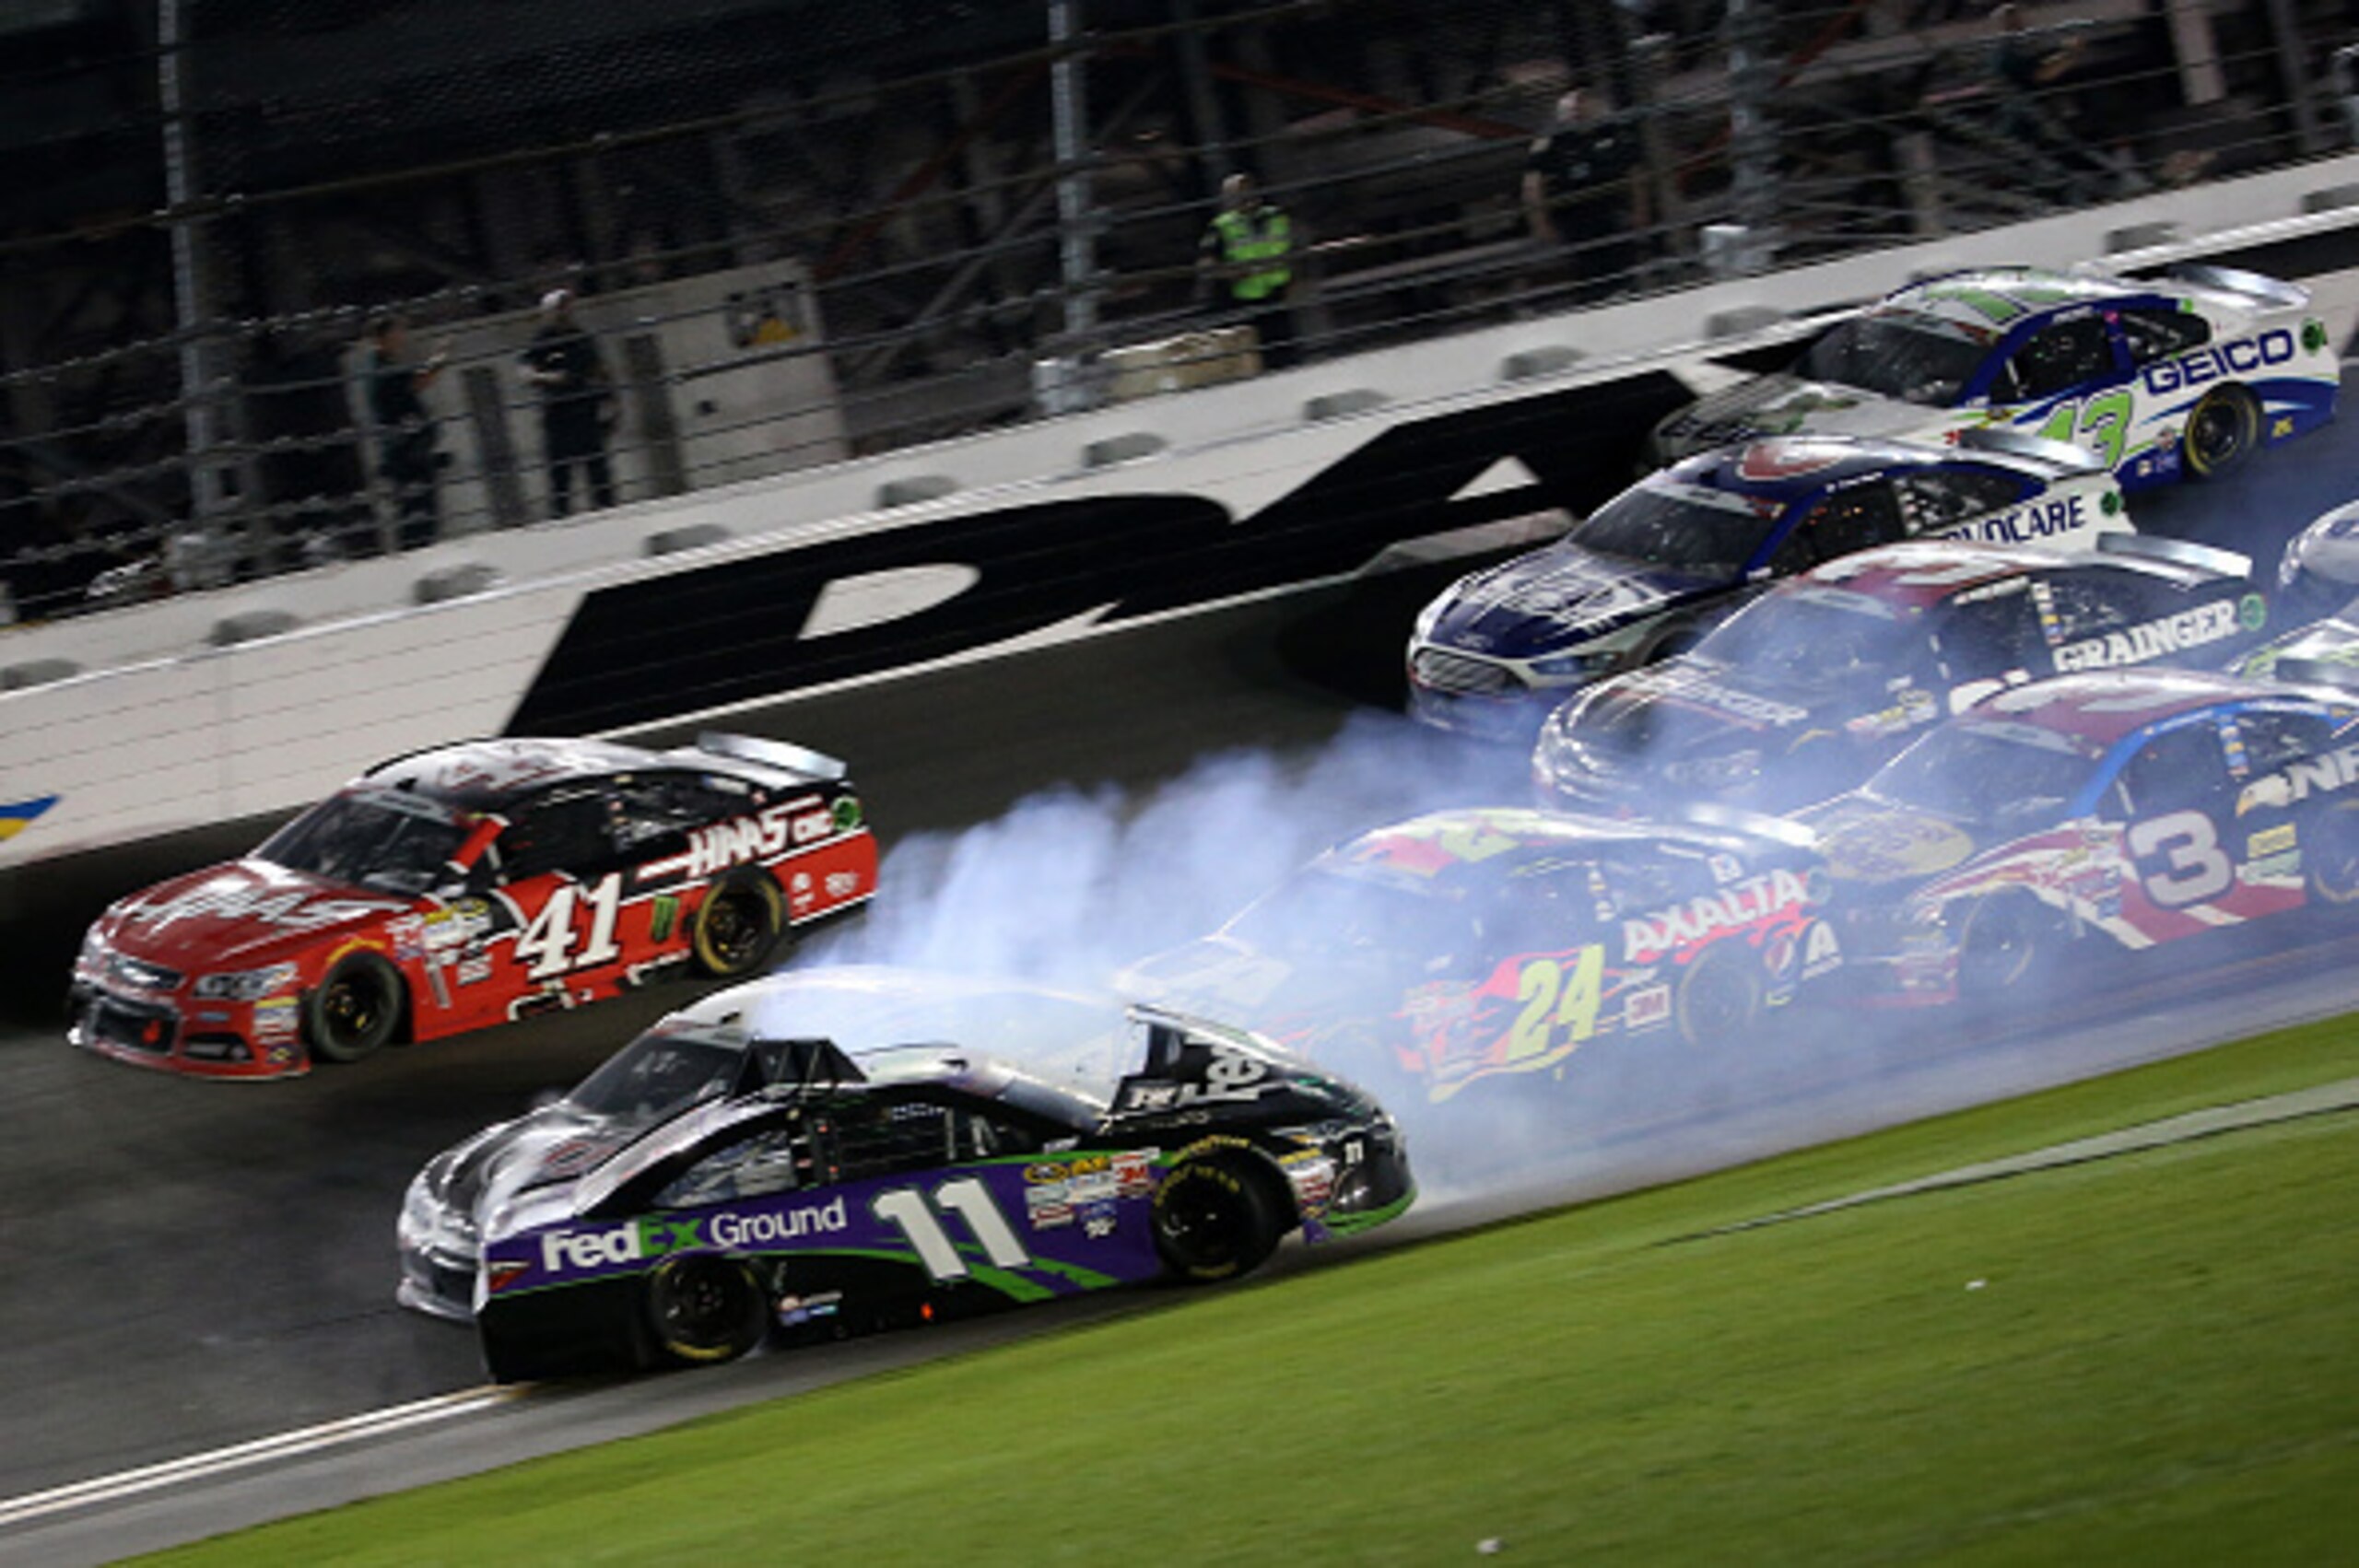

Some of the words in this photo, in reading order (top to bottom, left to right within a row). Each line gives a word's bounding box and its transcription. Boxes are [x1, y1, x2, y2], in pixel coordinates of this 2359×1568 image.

[2141, 329, 2294, 395] GEICO
[2051, 599, 2240, 673] GRAINGER
[684, 794, 823, 878] HAAS
[2129, 811, 2231, 907] 3
[515, 872, 621, 979] 41
[1623, 867, 1812, 962] AXALTA
[1506, 943, 1605, 1061] 24
[542, 1218, 704, 1272] FedEx
[710, 1198, 847, 1246] Ground
[874, 1177, 1031, 1281] 11
